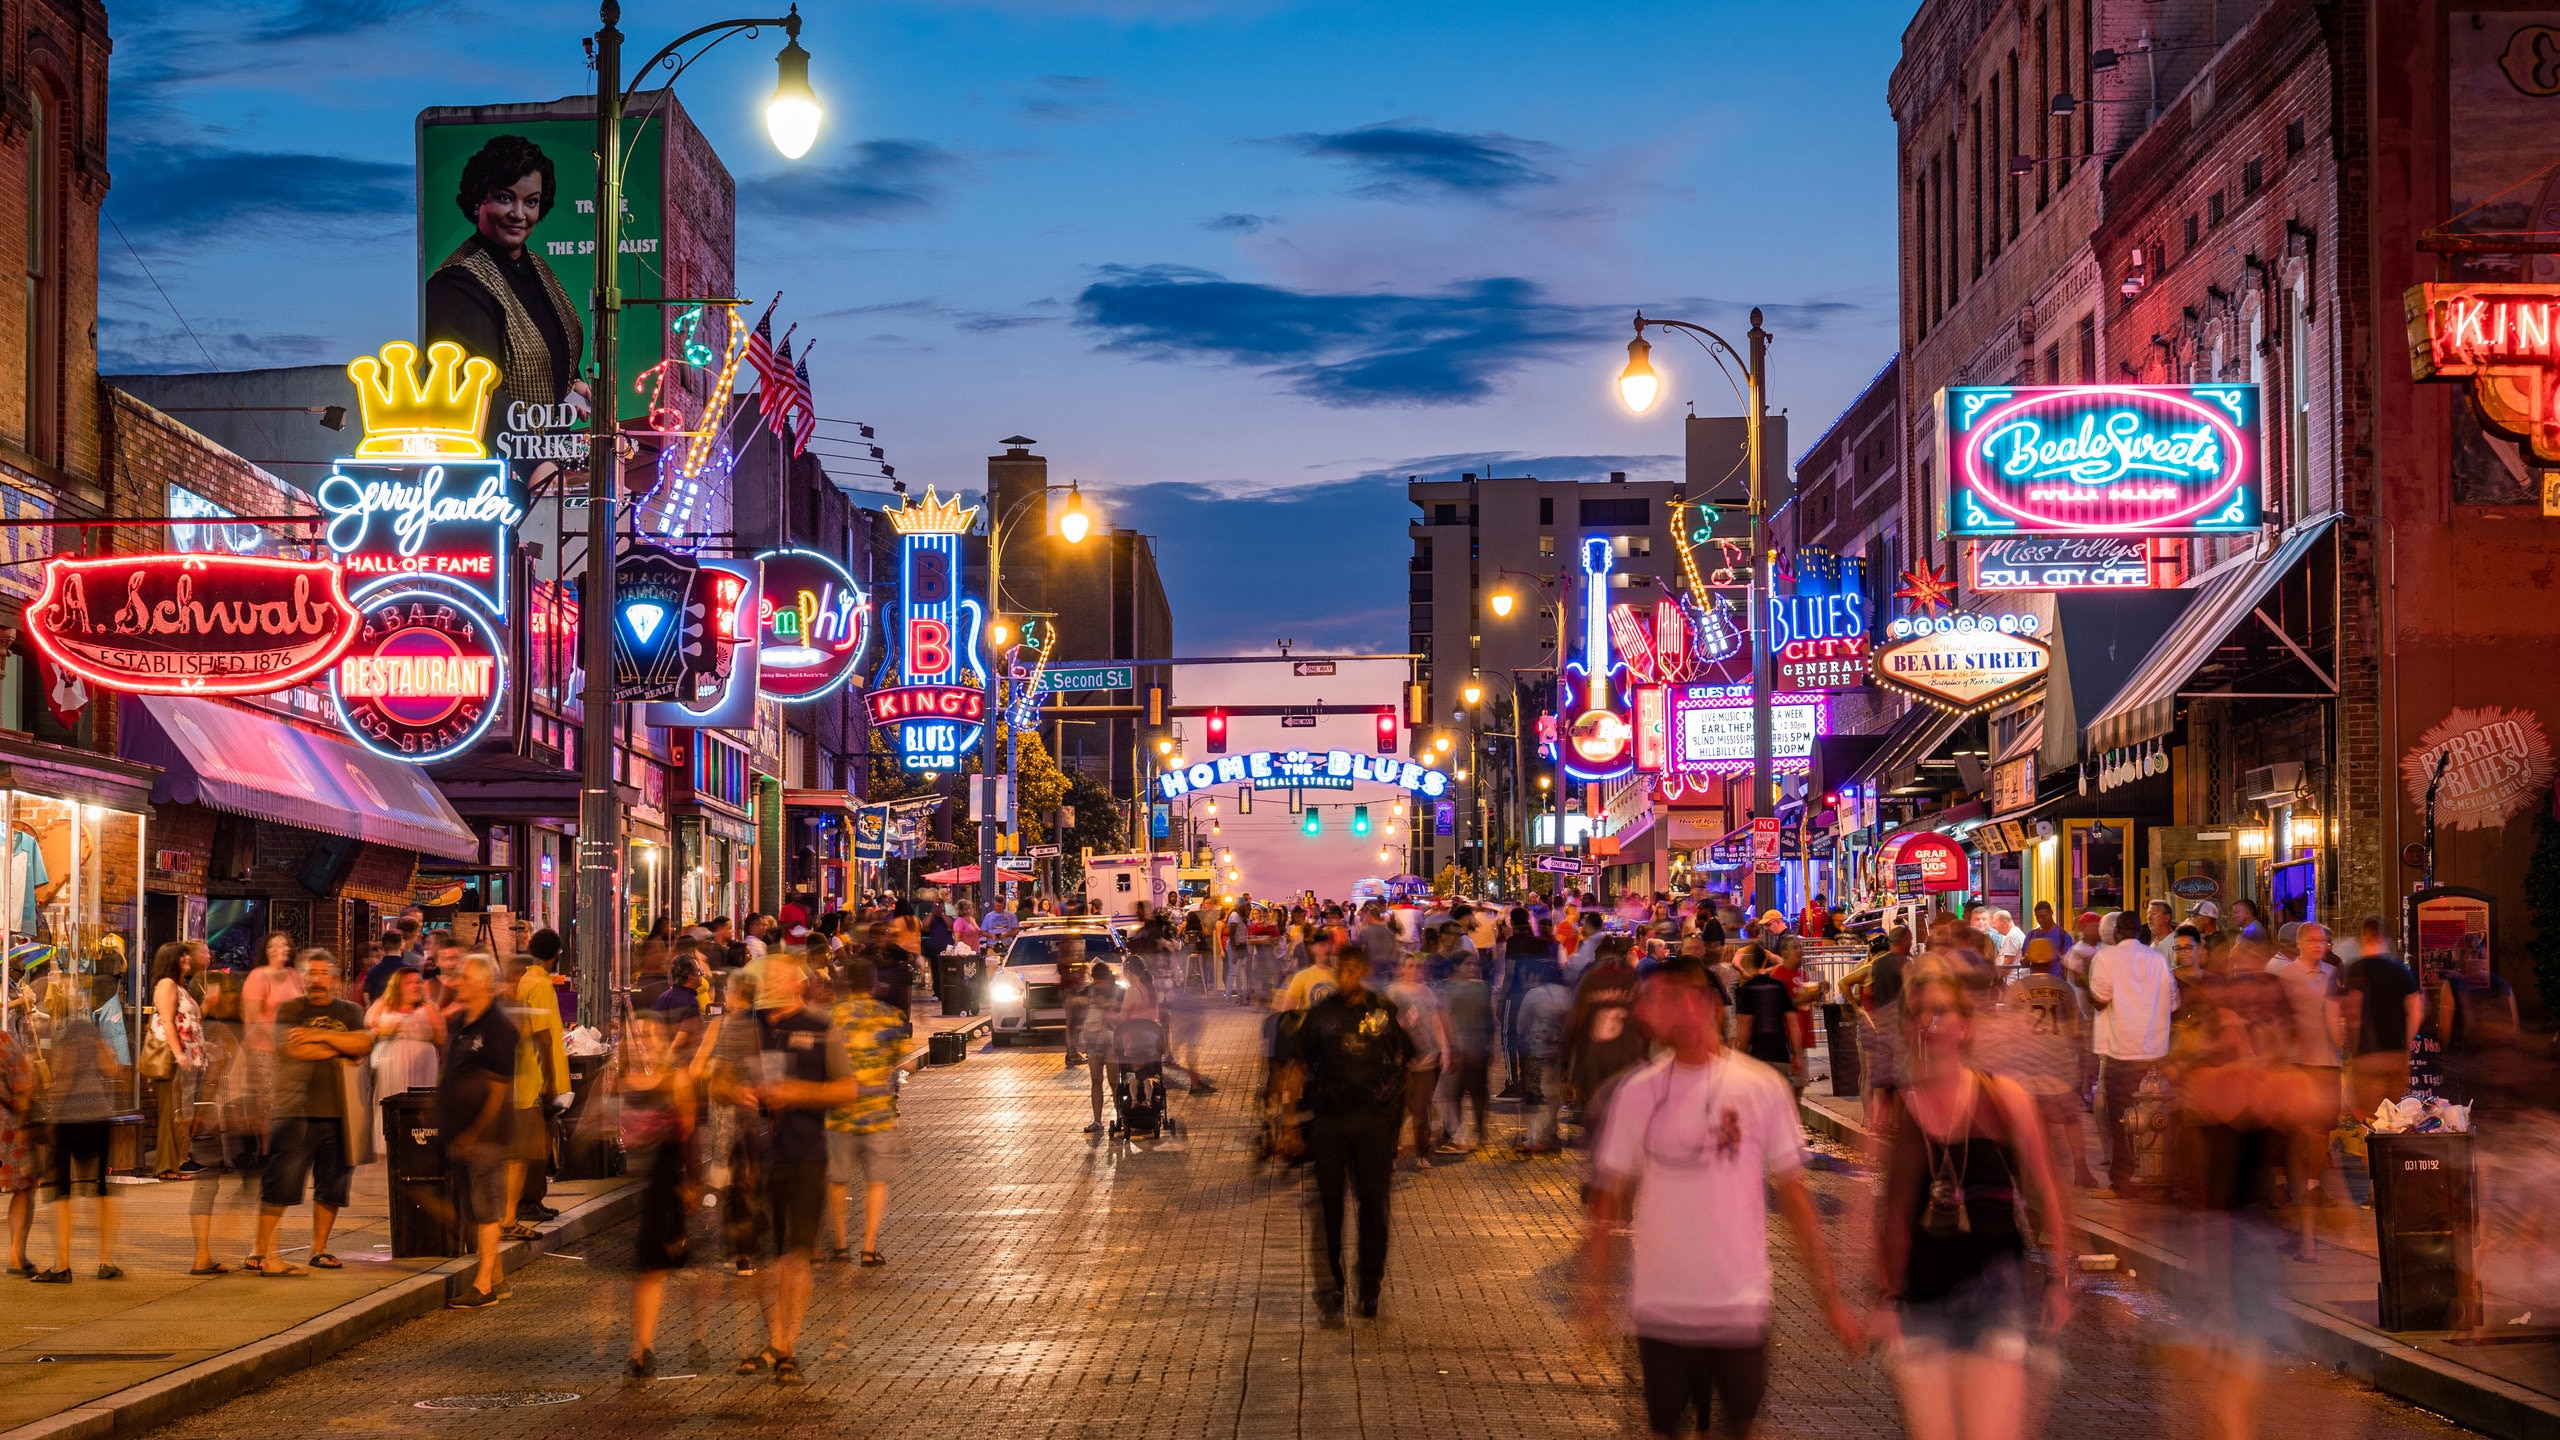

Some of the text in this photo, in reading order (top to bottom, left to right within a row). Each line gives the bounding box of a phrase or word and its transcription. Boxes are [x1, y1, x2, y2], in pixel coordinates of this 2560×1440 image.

[547, 239, 658, 255] THE SPALIST
[507, 400, 578, 432] GOLD
[401, 435, 437, 454] KING
[496, 431, 584, 460] STRIKE
[1982, 413, 2112, 476] Beale
[1978, 538, 2054, 563] Miss
[346, 556, 491, 573] HALL OF FAME
[1980, 568, 2147, 586] SOUL CITY CAFE
[45, 570, 338, 635] A. Schwab
[909, 550, 952, 676] B B
[377, 602, 457, 632] BAR
[760, 581, 872, 651] emphis
[1769, 592, 1861, 653] BLUES
[1894, 614, 2039, 637] WELCOME
[1784, 638, 1863, 660] CITY
[101, 650, 293, 675] ESTABLISHED 1876
[1783, 660, 1863, 676] GENERAL
[1893, 651, 2041, 672] BEALE STREET
[341, 655, 494, 698] RESTAURANT
[1053, 669, 1104, 688] Second
[1107, 667, 1127, 687] St.
[1797, 673, 1851, 688] STORE
[644, 684, 675, 700] BEALE
[1688, 685, 1752, 699] BLUES CITY
[878, 691, 980, 718] KING'S
[1701, 713, 1716, 723] LIVE
[1718, 711, 1740, 721] MUSIC
[1785, 709, 1804, 719] WEEK
[349, 703, 391, 741] 159
[400, 704, 484, 753] BEALE
[905, 725, 955, 752] BLUES
[1701, 724, 1726, 734] EARL
[1717, 734, 1754, 745] MISSISSIPP
[1790, 732, 1811, 742] 5PM
[905, 755, 955, 768] CLUB
[1700, 746, 1737, 757] HILLBILLY
[2418, 720, 2530, 782] BURRITO
[1159, 749, 1448, 799] HOME OF THE BLUES
[1262, 776, 1346, 788] BEALE STREET
[2445, 749, 2521, 798] BLUES
[2456, 777, 2525, 811] MEXICAN GRILL
[1759, 820, 1775, 830] NO
[1550, 859, 1563, 868] ONE
[1564, 861, 1578, 869] WAY
[1914, 849, 1947, 859] GRAB
[1922, 862, 1947, 872] UDS
[2030, 1004, 2060, 1036] 21
